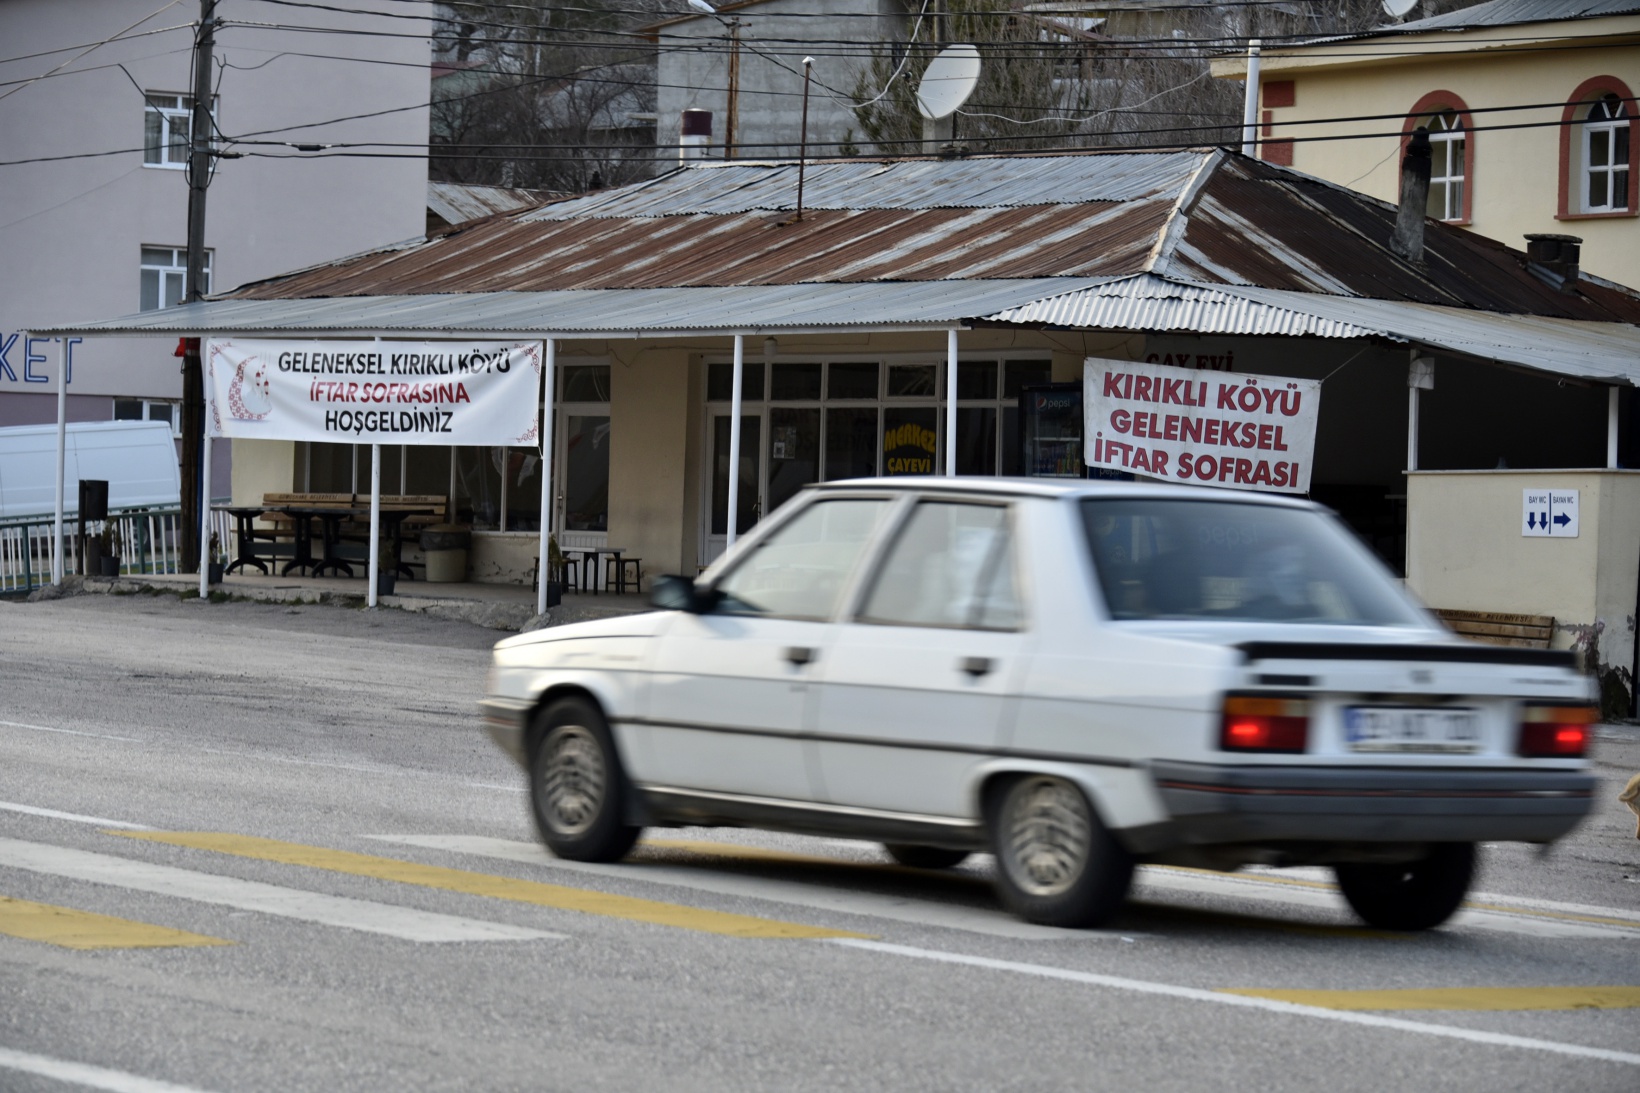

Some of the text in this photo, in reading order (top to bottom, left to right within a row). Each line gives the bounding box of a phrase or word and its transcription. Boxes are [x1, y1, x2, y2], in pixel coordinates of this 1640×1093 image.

[278, 348, 511, 375] GELENEKSEL KIRIKLI KÖYÜ
[310, 376, 471, 404] İFTAR SOFRASINA
[1047, 397, 1071, 410] pepsi
[1103, 371, 1302, 416] KIRIKLI KÖYÜ
[325, 406, 454, 436] HOŞGELDİNİZ
[1110, 408, 1289, 451] GELENEKSEL
[884, 422, 936, 454] MERKEZ
[887, 454, 931, 475] ÇAYEVİ
[1094, 431, 1300, 488] İFTAR SOFRASI
[1528, 495, 1547, 504] BAY WC
[1552, 496, 1567, 504] BAYAN
